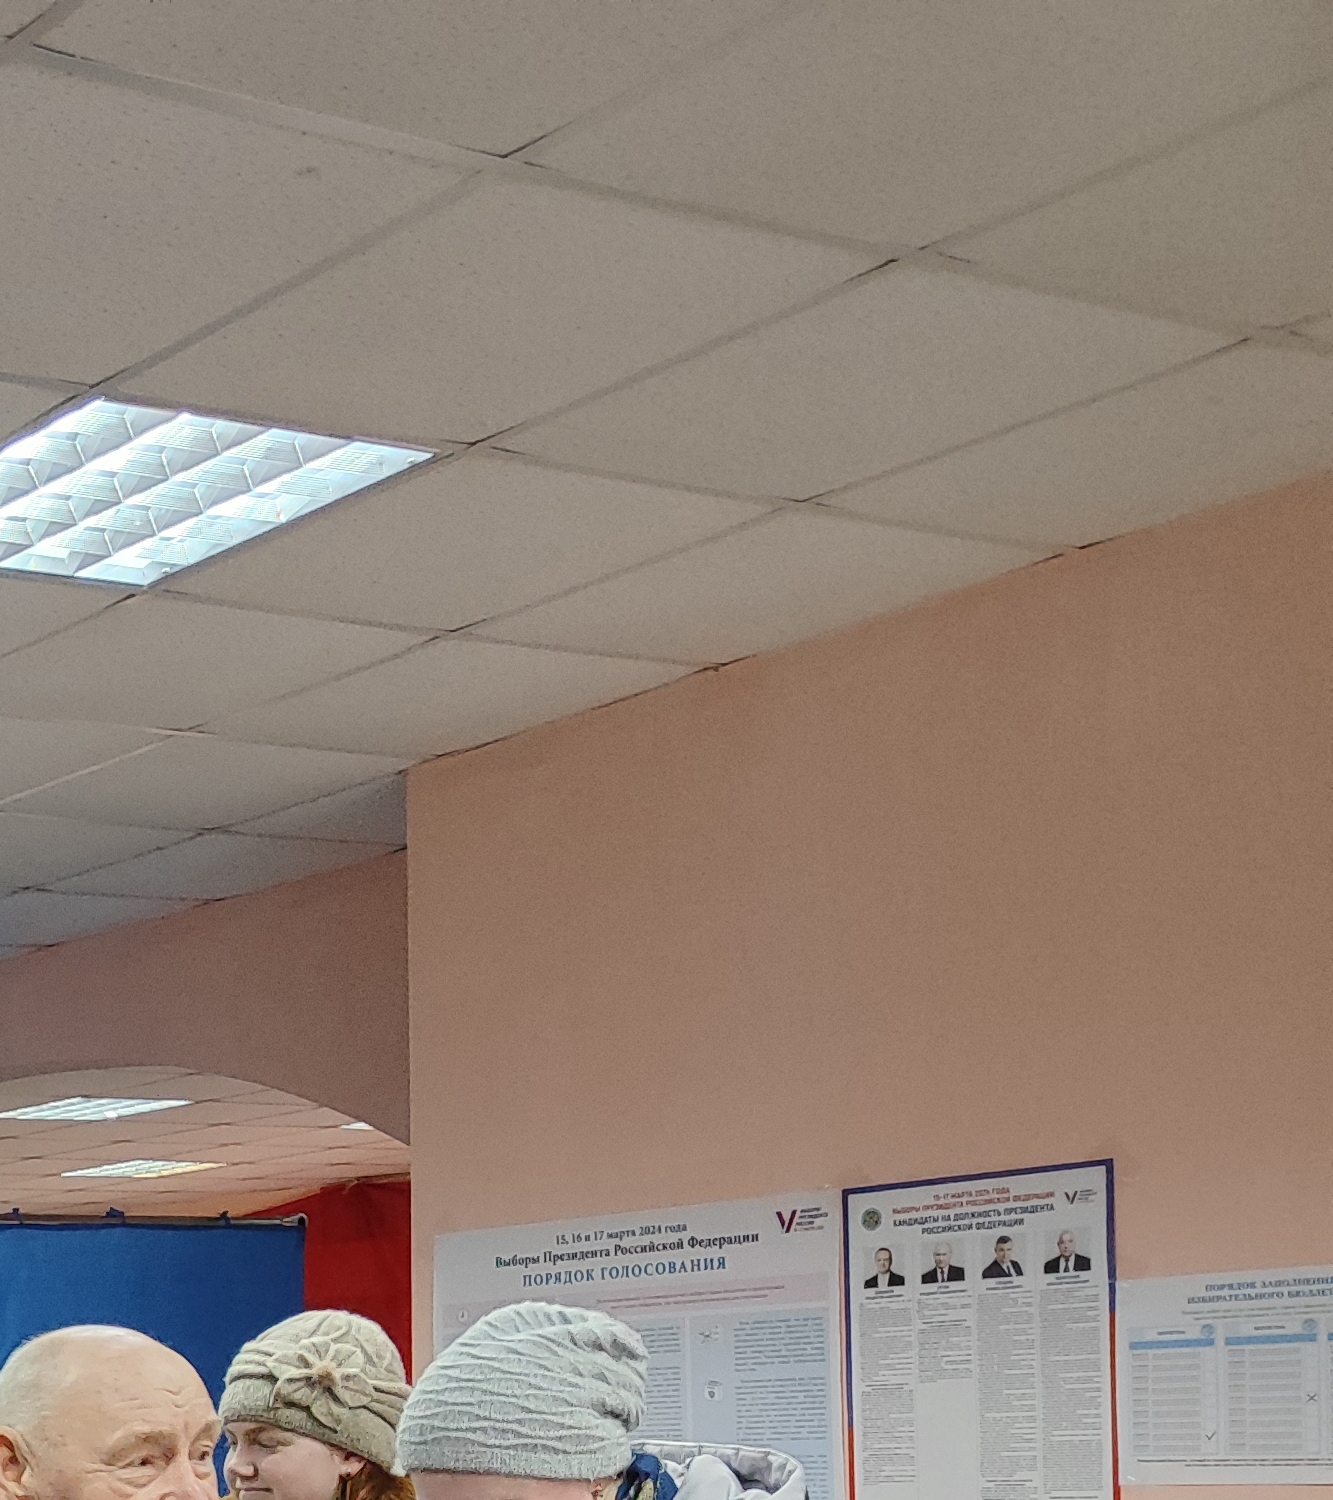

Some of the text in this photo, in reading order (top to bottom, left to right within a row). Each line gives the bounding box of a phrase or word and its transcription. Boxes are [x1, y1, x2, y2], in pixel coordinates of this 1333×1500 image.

[991, 1186, 1011, 1195] ГОДА
[1012, 1190, 1056, 1203] ФЕДЕРАЦИИ
[893, 1203, 1055, 1228] КАНДИДАТЫ НА ДОЛЖНОСТЬ ПРЕЗИДЕНТА
[555, 1234, 570, 1247] 15,
[571, 1232, 583, 1244] 16
[593, 1229, 605, 1241] 17
[606, 1228, 637, 1243] марта
[639, 1223, 663, 1237] 2024
[664, 1222, 688, 1236] года
[921, 1217, 1025, 1235] РОССИЙСКОЙ ФЕДЕРАЦИИ
[495, 1232, 760, 1269] Выборы Президента Российской Федерации
[522, 1256, 727, 1287] ПОРЯДОК ГОЛОСОВАНИЯ
[1205, 1281, 1257, 1292] ПОРЯДОК
[1187, 1291, 1285, 1304] ИЗБИРАТЕЛЬНОГО
